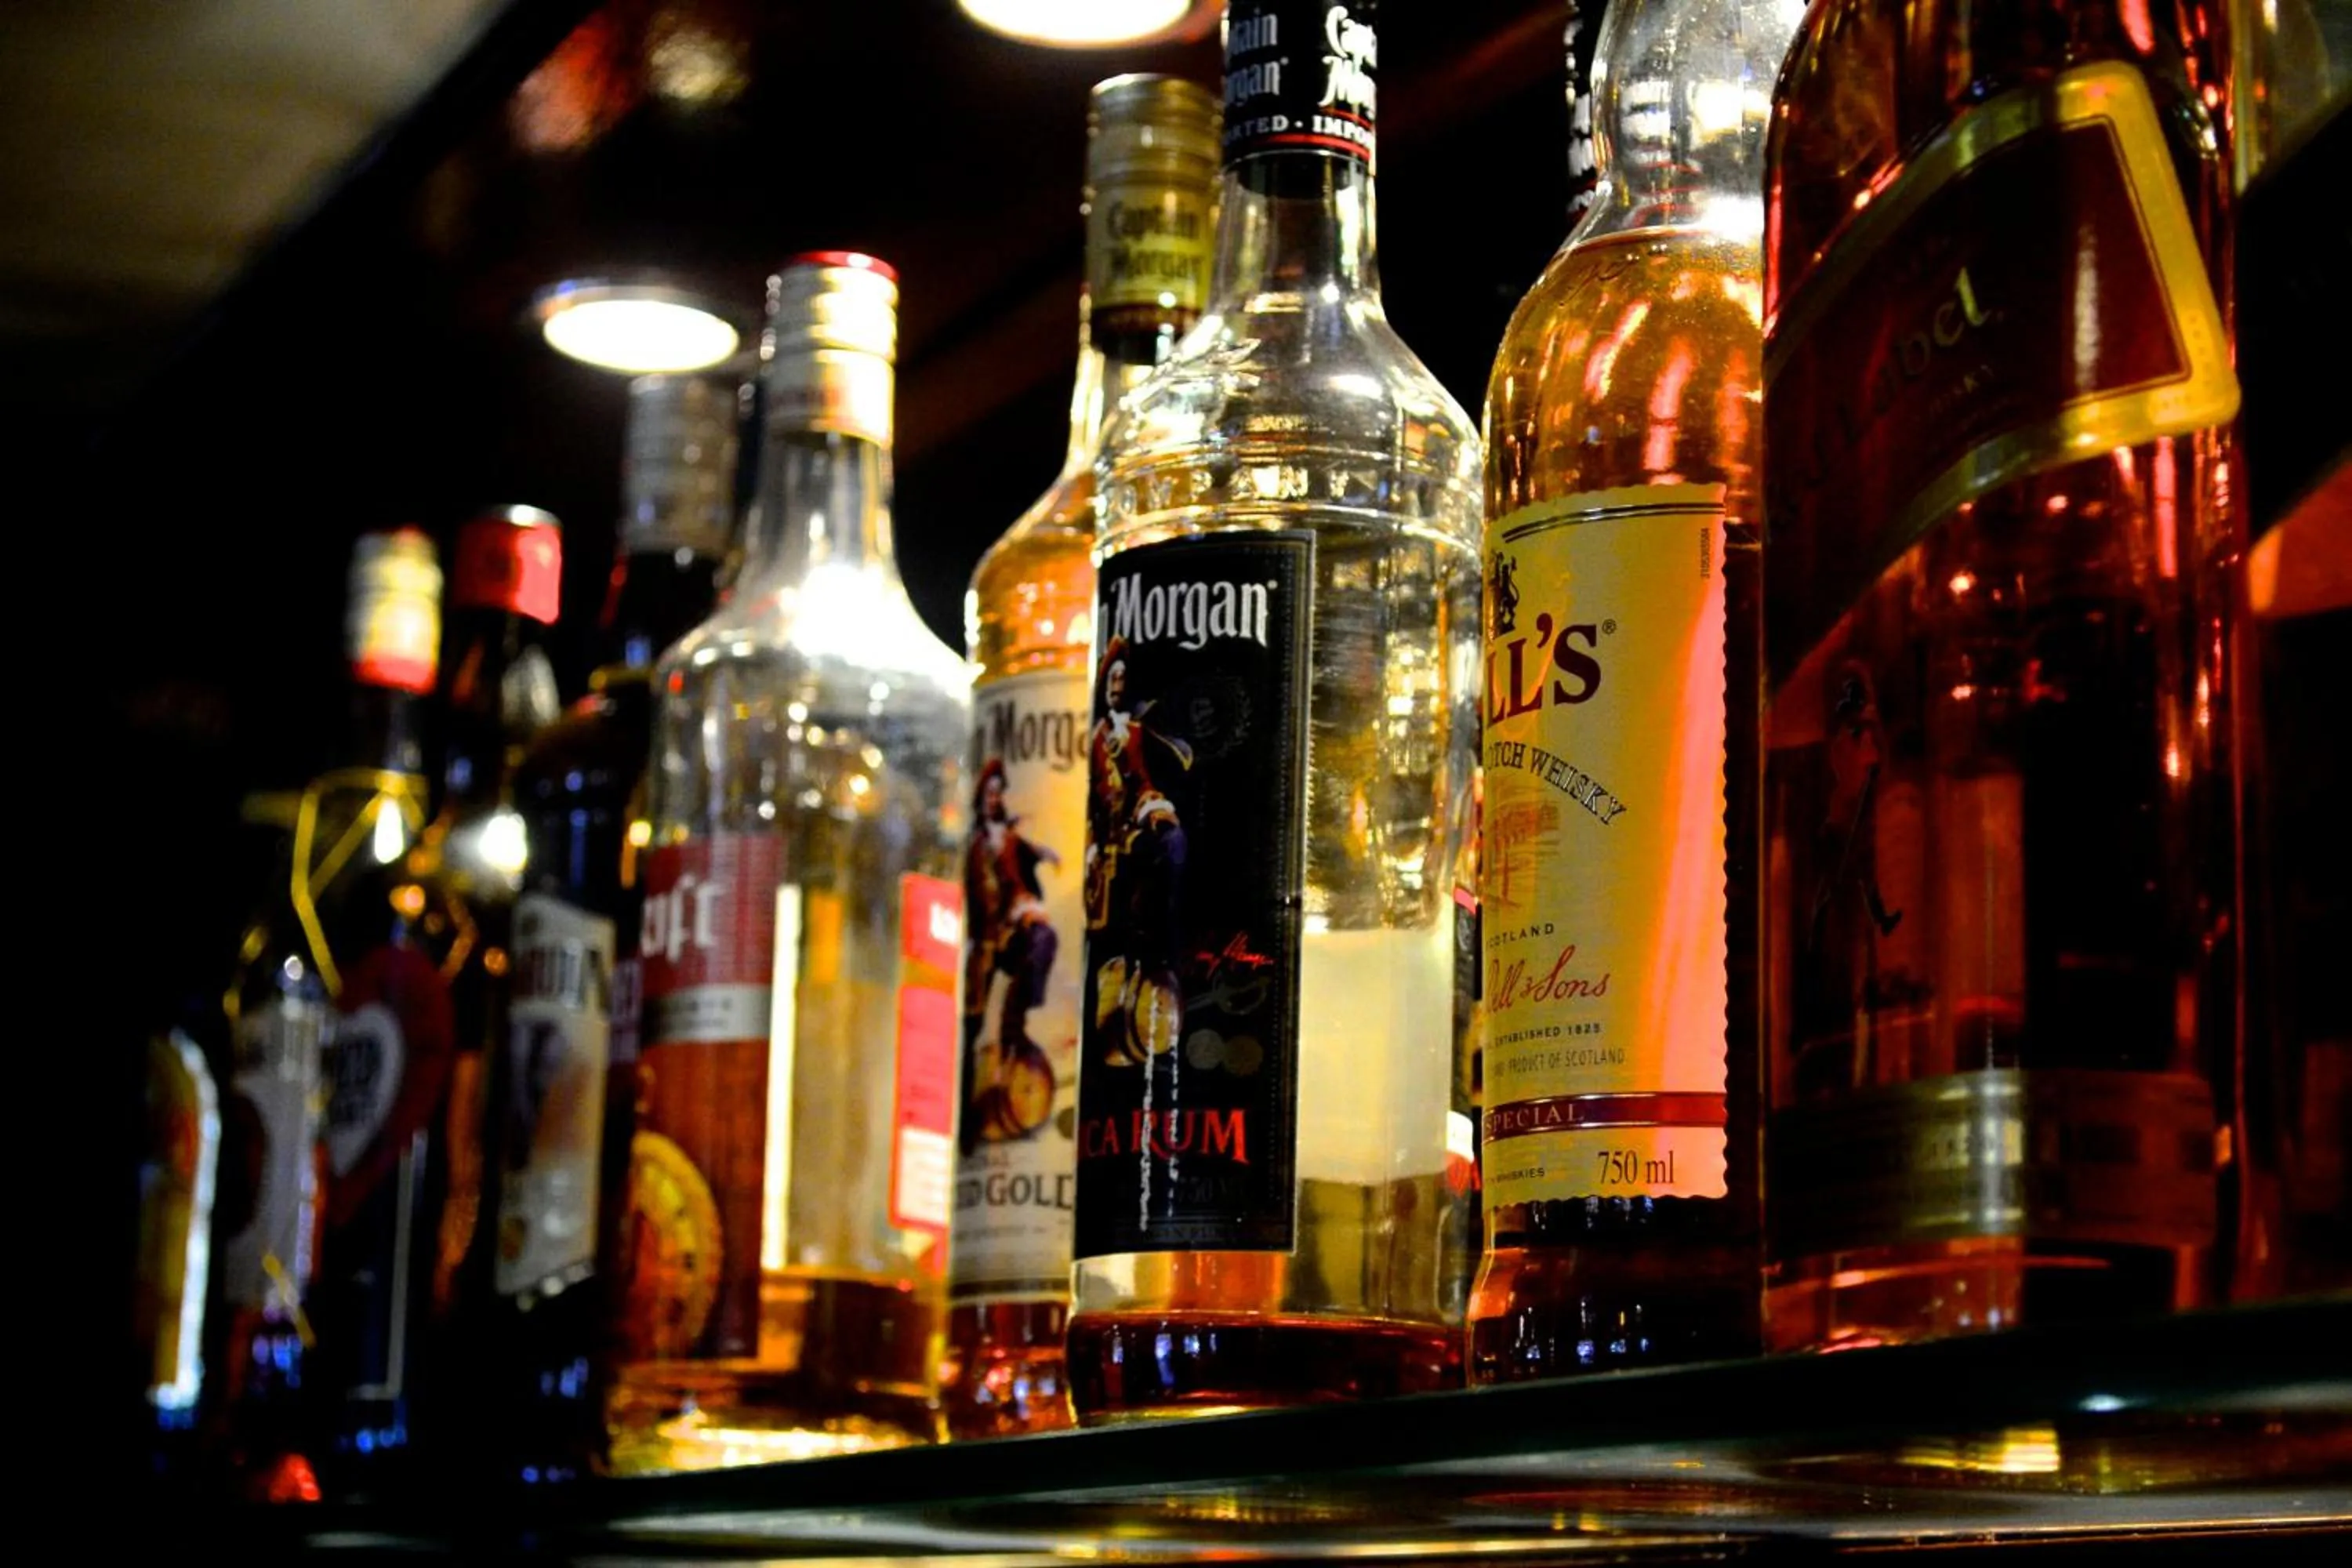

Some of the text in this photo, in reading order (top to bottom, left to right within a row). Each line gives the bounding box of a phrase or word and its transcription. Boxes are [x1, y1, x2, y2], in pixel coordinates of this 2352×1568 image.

[1110, 572, 1269, 652] Morgan
[1530, 746, 1628, 826] WHISKY
[1548, 1052, 1561, 1069] OF
[1565, 1047, 1625, 1068] SCOTLAND
[1129, 1108, 1252, 1165] RUM
[1598, 1149, 1675, 1185] 750 ml
